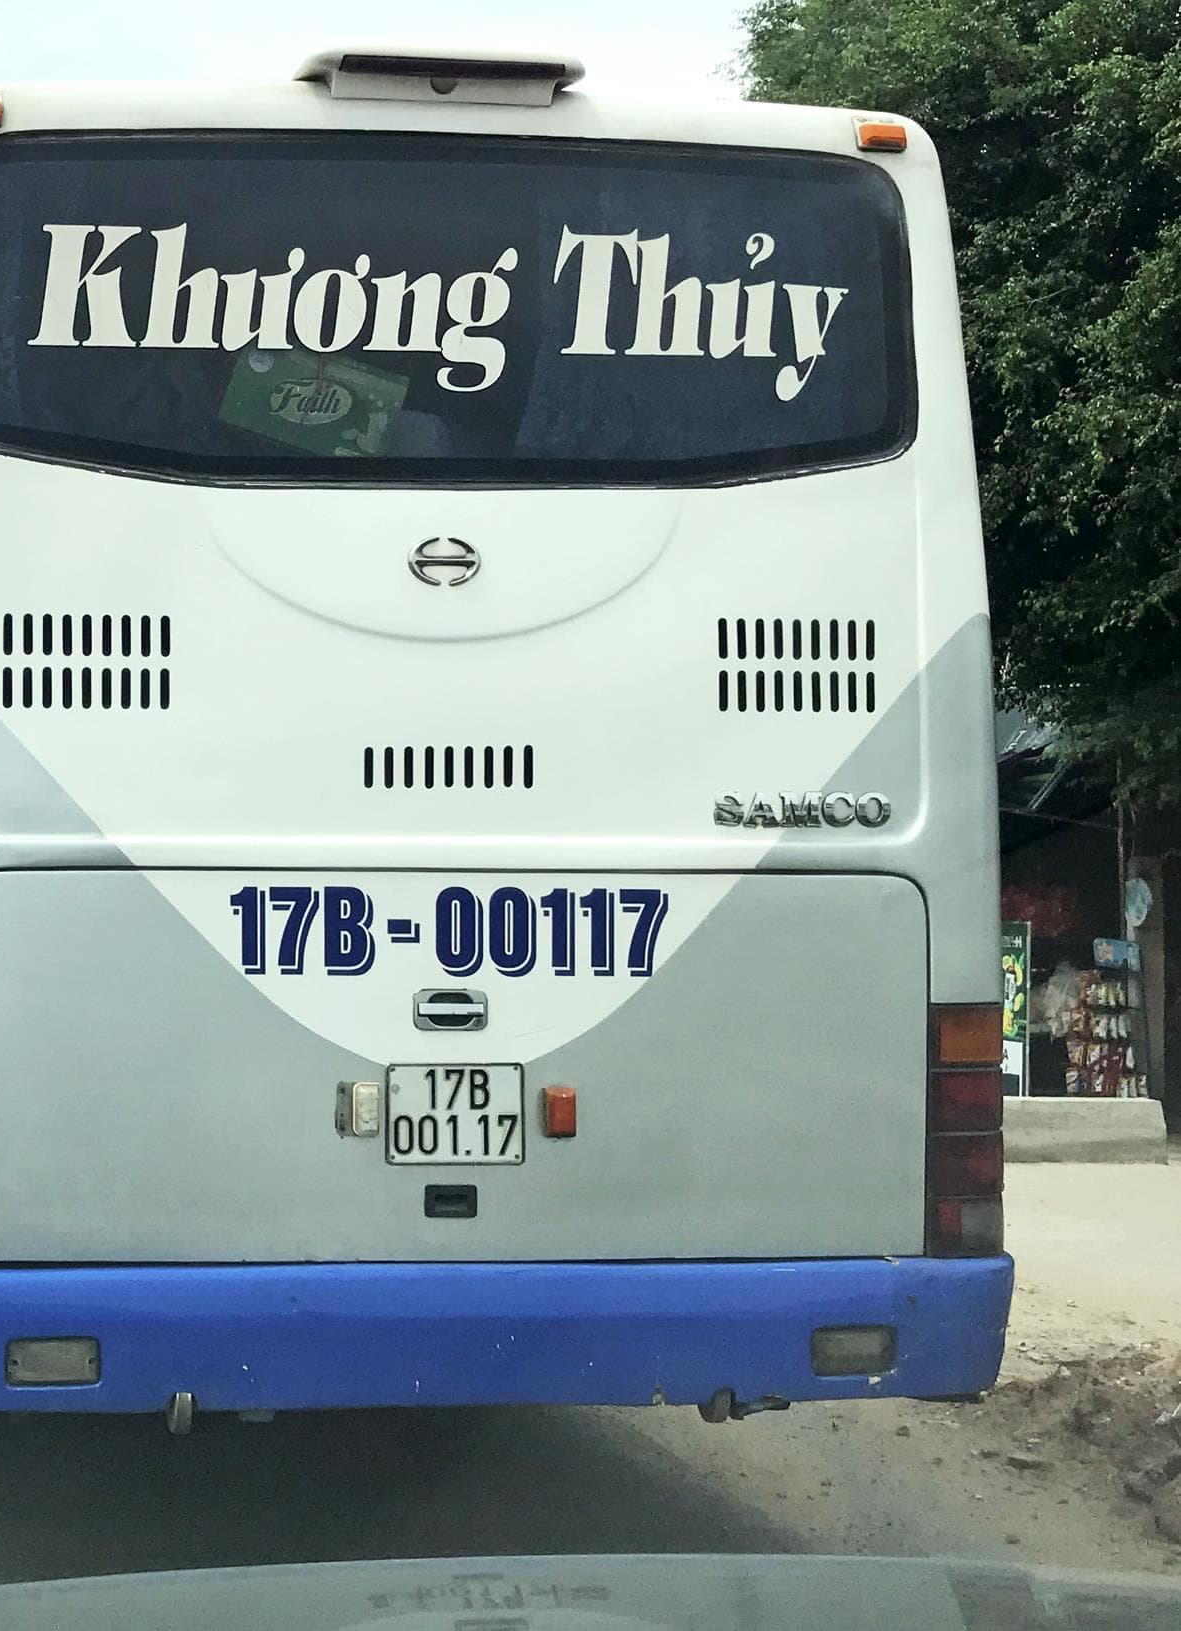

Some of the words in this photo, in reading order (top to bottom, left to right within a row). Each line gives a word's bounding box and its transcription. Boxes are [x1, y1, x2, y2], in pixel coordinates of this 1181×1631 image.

[27, 222, 518, 393] Khương
[553, 224, 849, 401] Thủy
[714, 791, 892, 829] SAMCO
[425, 1069, 490, 1110] 17B
[394, 1115, 518, 1157] 001.17
